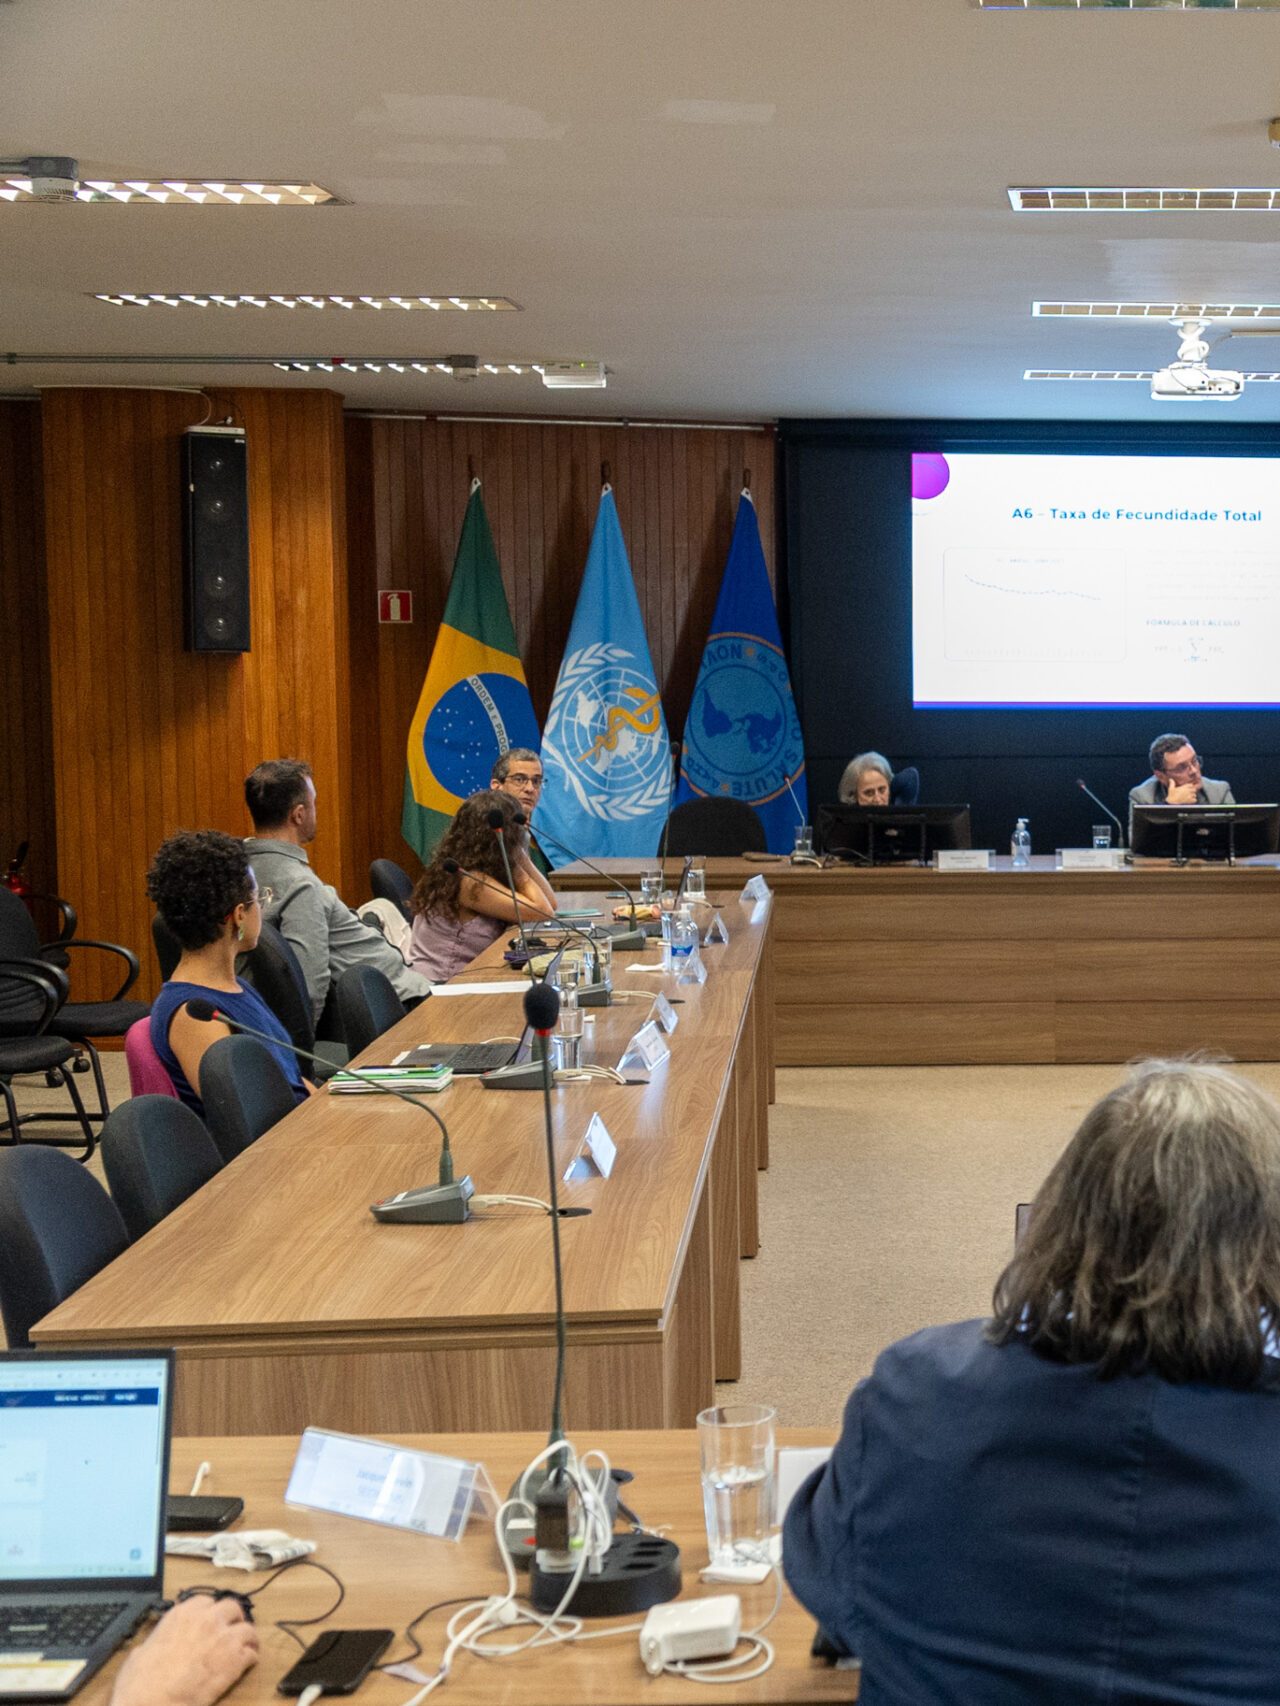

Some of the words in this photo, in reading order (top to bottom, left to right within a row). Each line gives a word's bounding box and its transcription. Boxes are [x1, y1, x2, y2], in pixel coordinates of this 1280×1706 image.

[1012, 508, 1033, 519] A6
[1050, 508, 1086, 520] Taxa
[1092, 508, 1111, 520] de
[1116, 508, 1218, 521] Fecundidade
[1223, 510, 1262, 521] Total
[470, 677, 495, 712] ORDEM
[495, 723, 508, 753] PROG
